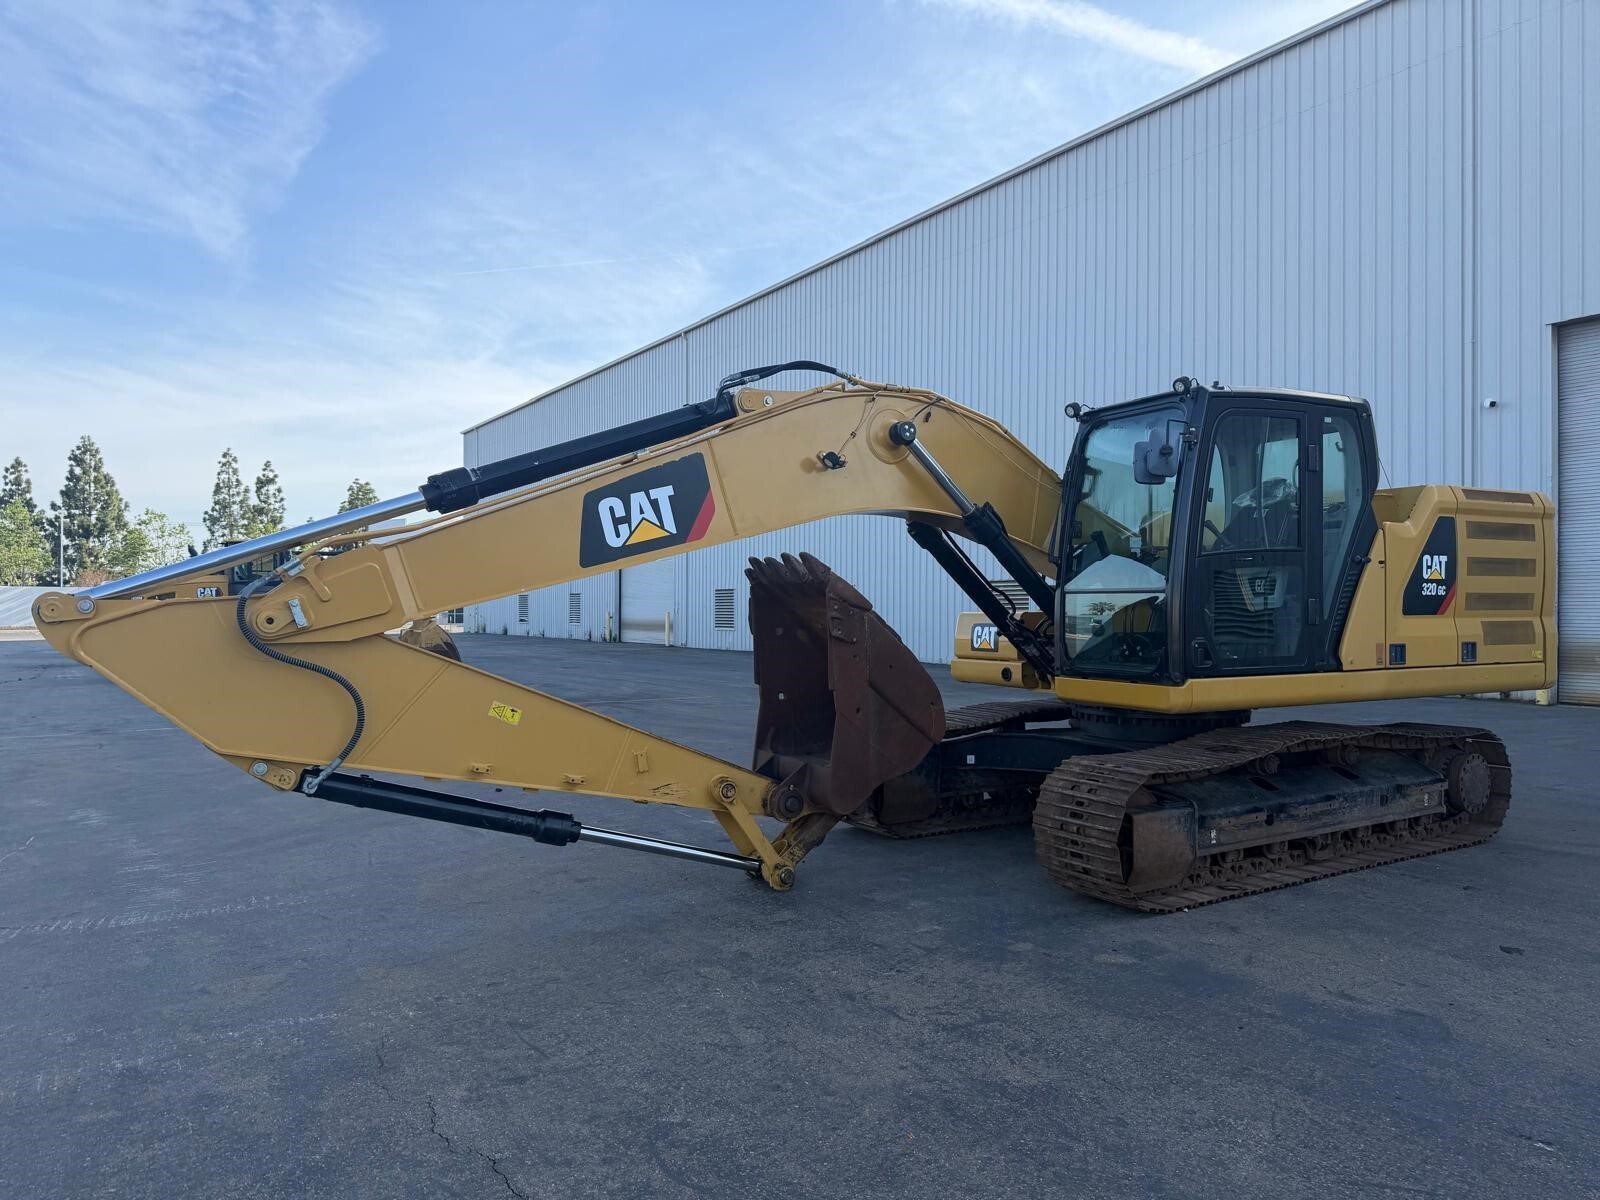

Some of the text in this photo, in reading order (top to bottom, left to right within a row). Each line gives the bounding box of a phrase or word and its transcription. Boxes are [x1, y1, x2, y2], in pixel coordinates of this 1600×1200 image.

[598, 485, 677, 548] CAT
[1422, 554, 1448, 580] CAT
[197, 587, 218, 598] CAT
[1421, 582, 1446, 596] 320 GC
[972, 626, 998, 649] CAT
